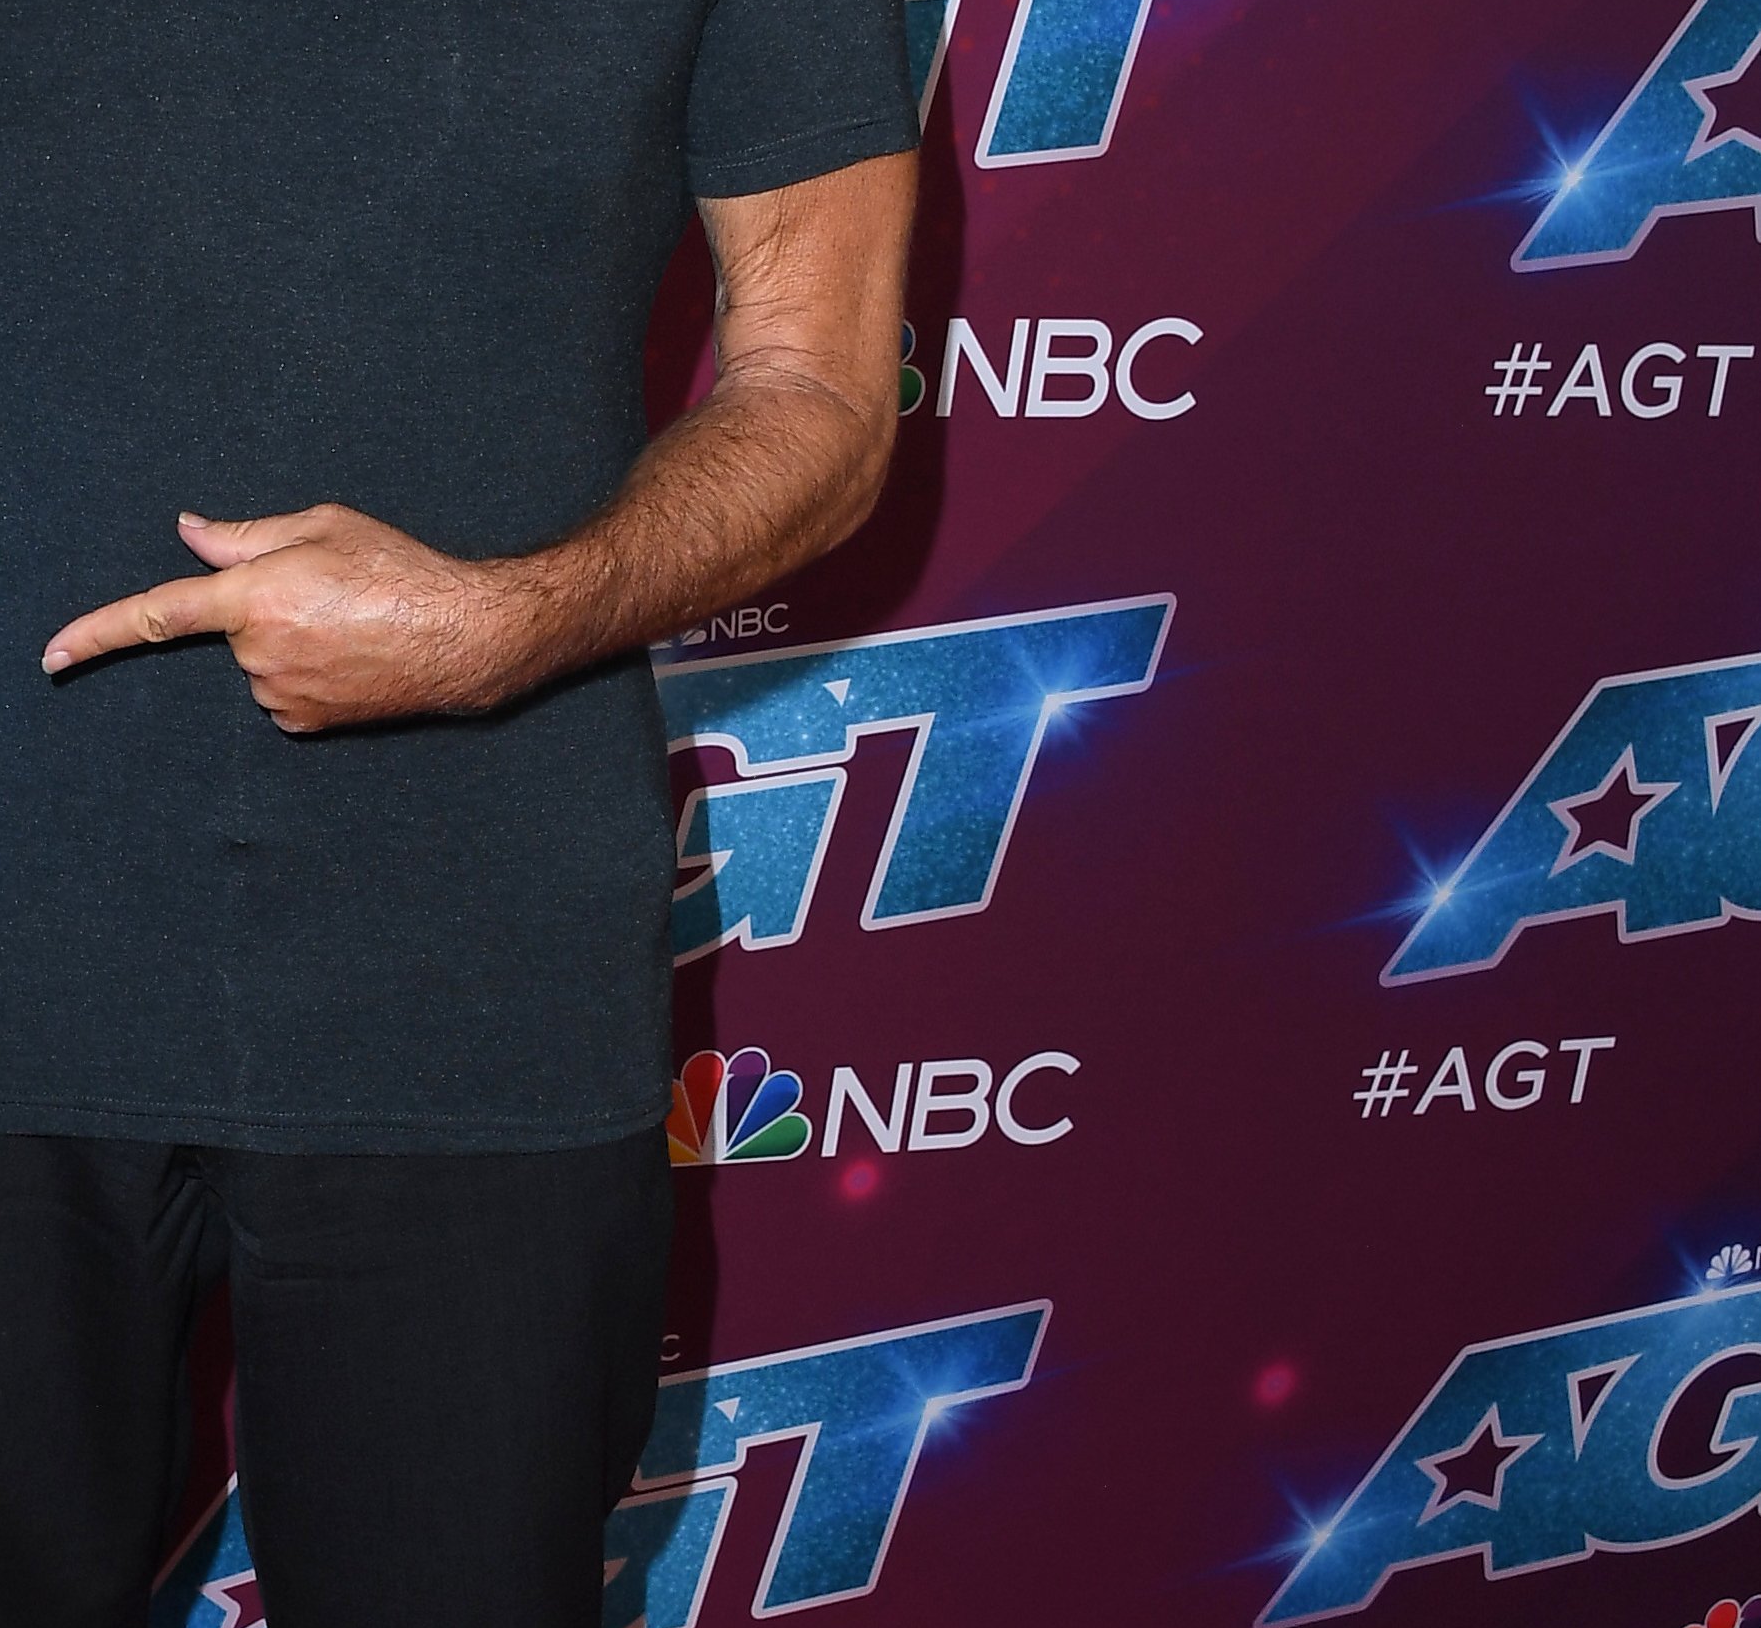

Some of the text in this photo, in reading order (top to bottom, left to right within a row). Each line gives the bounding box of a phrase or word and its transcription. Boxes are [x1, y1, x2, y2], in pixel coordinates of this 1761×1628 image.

[935, 318, 1203, 419] NBC
[1486, 343, 1754, 418] #AGT
[710, 604, 788, 641] NBC
[822, 1052, 1080, 1157] NBC
[1354, 1037, 1615, 1118] #AGT
